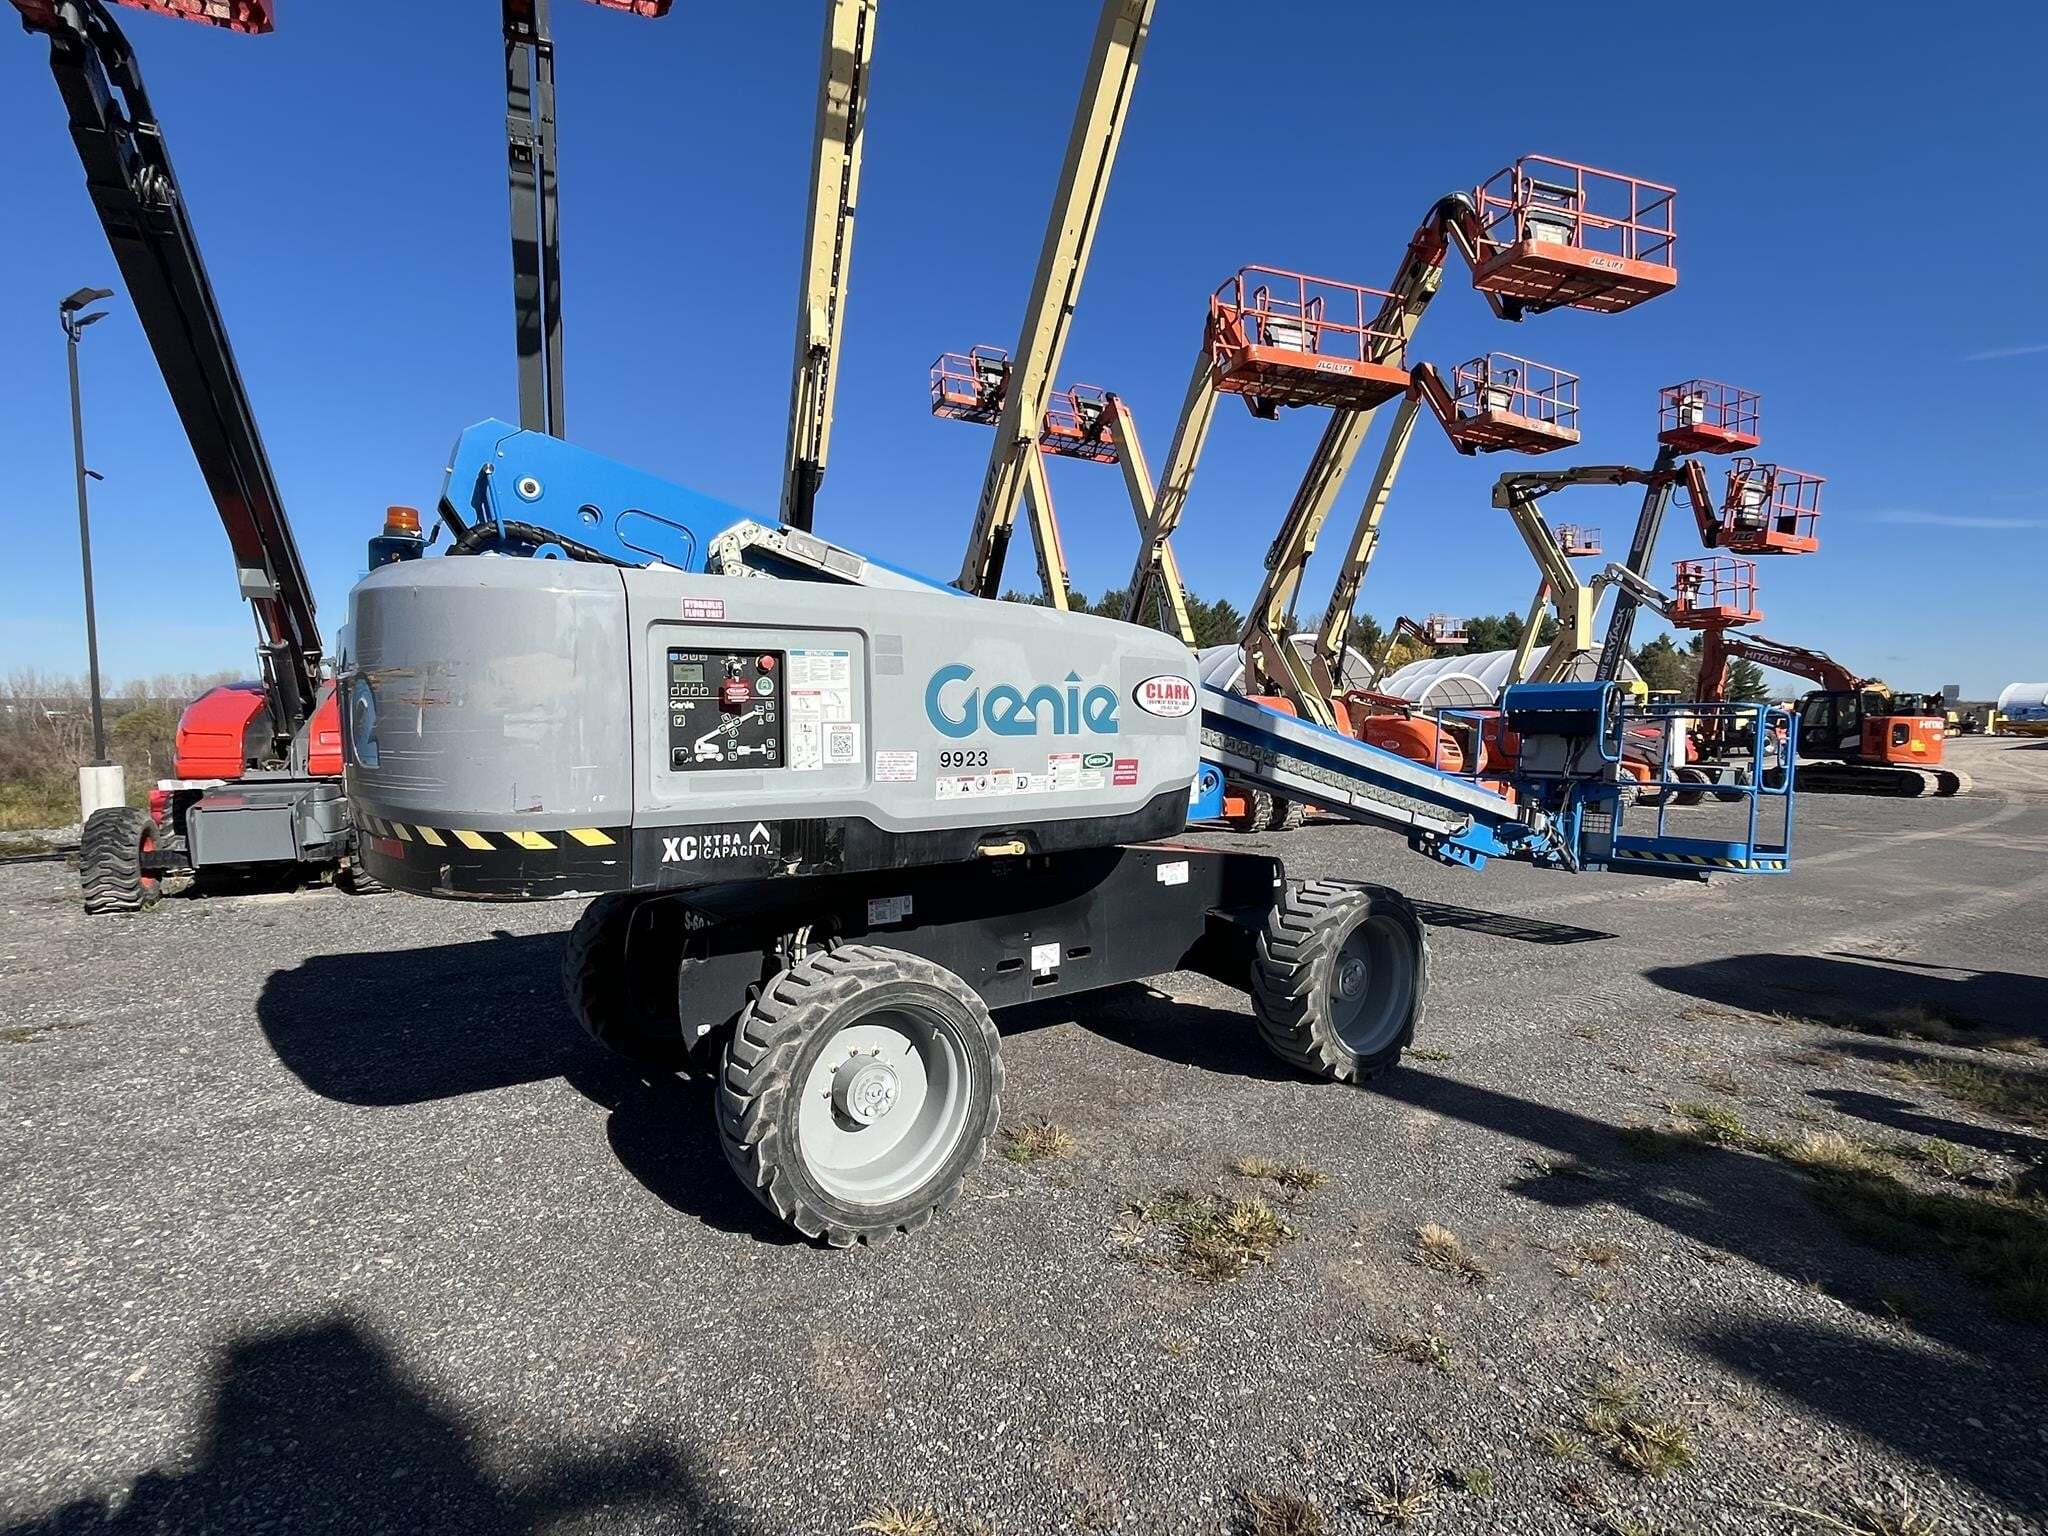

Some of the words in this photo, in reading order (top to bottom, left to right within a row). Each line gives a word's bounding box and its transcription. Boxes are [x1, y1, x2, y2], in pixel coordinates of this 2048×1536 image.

[1591, 257, 1605, 266] JLG
[1607, 260, 1624, 270] LIFT
[1318, 362, 1332, 370] JLG
[1334, 364, 1353, 373] LIFT
[1604, 608, 1627, 664] SKYJACK
[1744, 649, 1791, 667] HITACHI
[1145, 682, 1190, 700] CLARK
[669, 700, 696, 710] Genie
[925, 662, 1121, 740] Genie
[940, 750, 989, 768] 9923
[661, 835, 698, 863] XC
[703, 833, 742, 847] XTRA
[703, 843, 770, 860] CAPACITY
